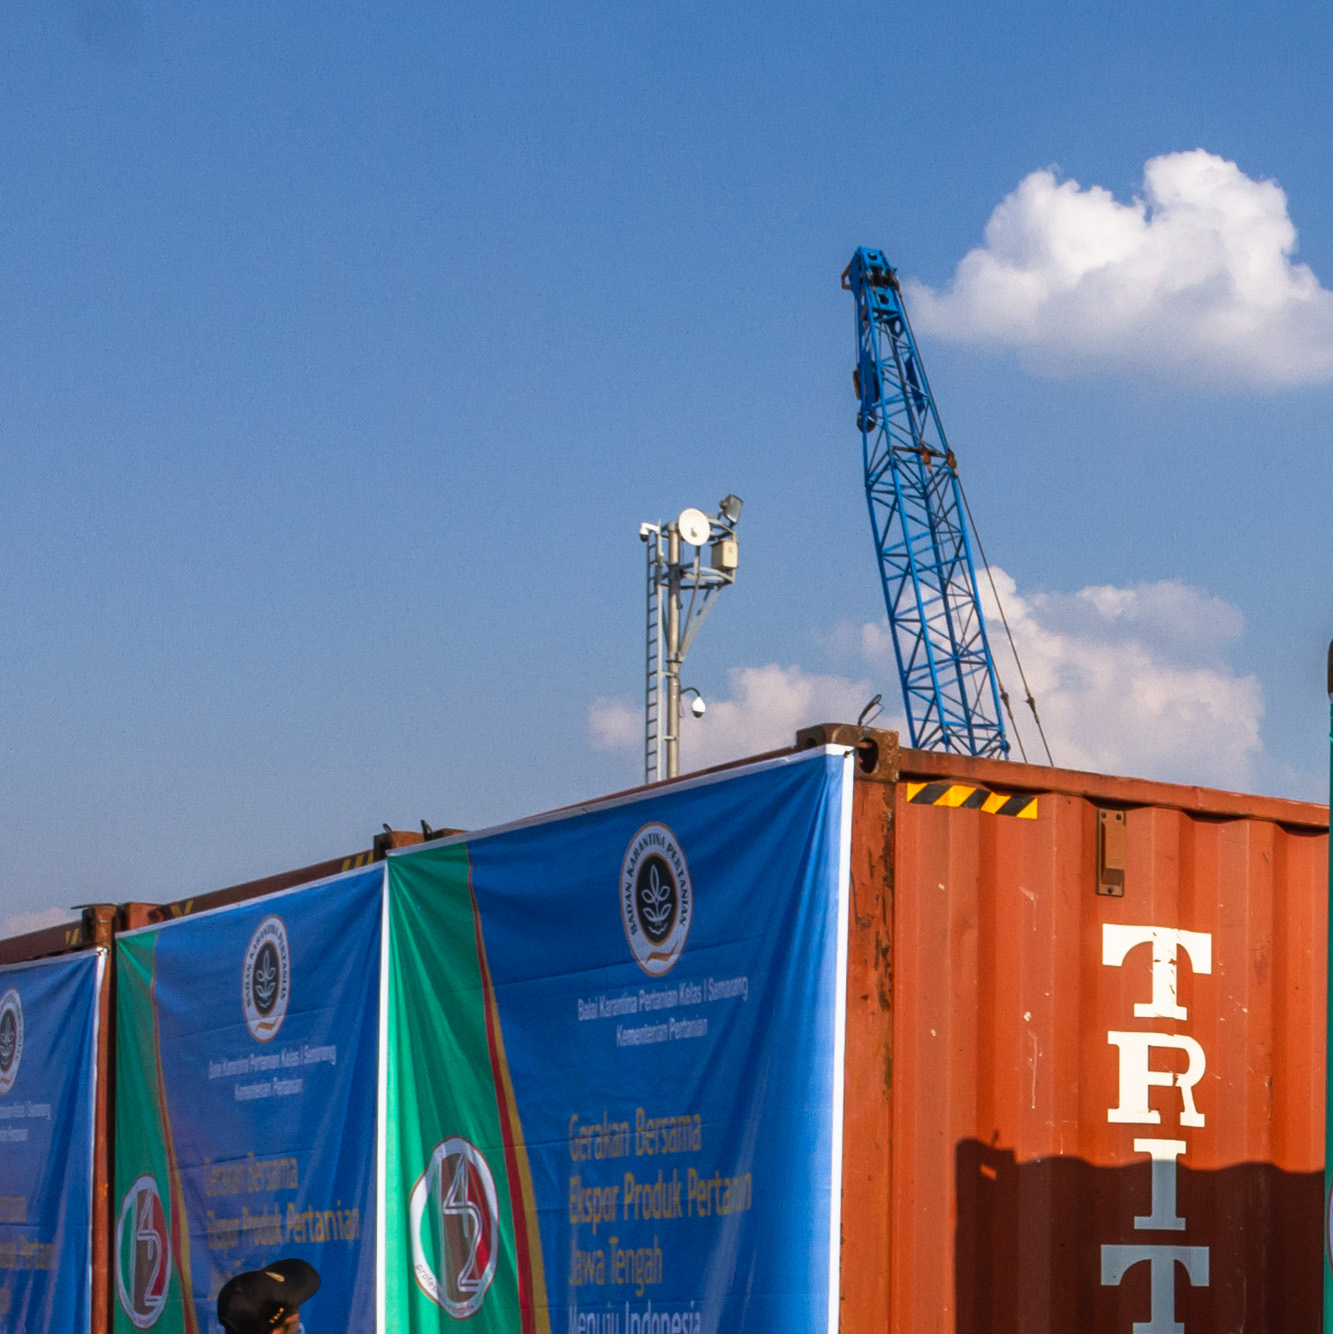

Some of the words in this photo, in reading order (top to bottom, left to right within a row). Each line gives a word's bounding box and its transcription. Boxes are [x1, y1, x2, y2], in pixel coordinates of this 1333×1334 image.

[569, 1110, 629, 1162] Gerakan
[635, 1106, 701, 1156] Bersama
[286, 1199, 361, 1244] Pertanian
[569, 1174, 619, 1235] Ekspor
[624, 1168, 682, 1221] Produk
[569, 1238, 605, 1286] Jawa
[608, 1235, 662, 1297] Tengah
